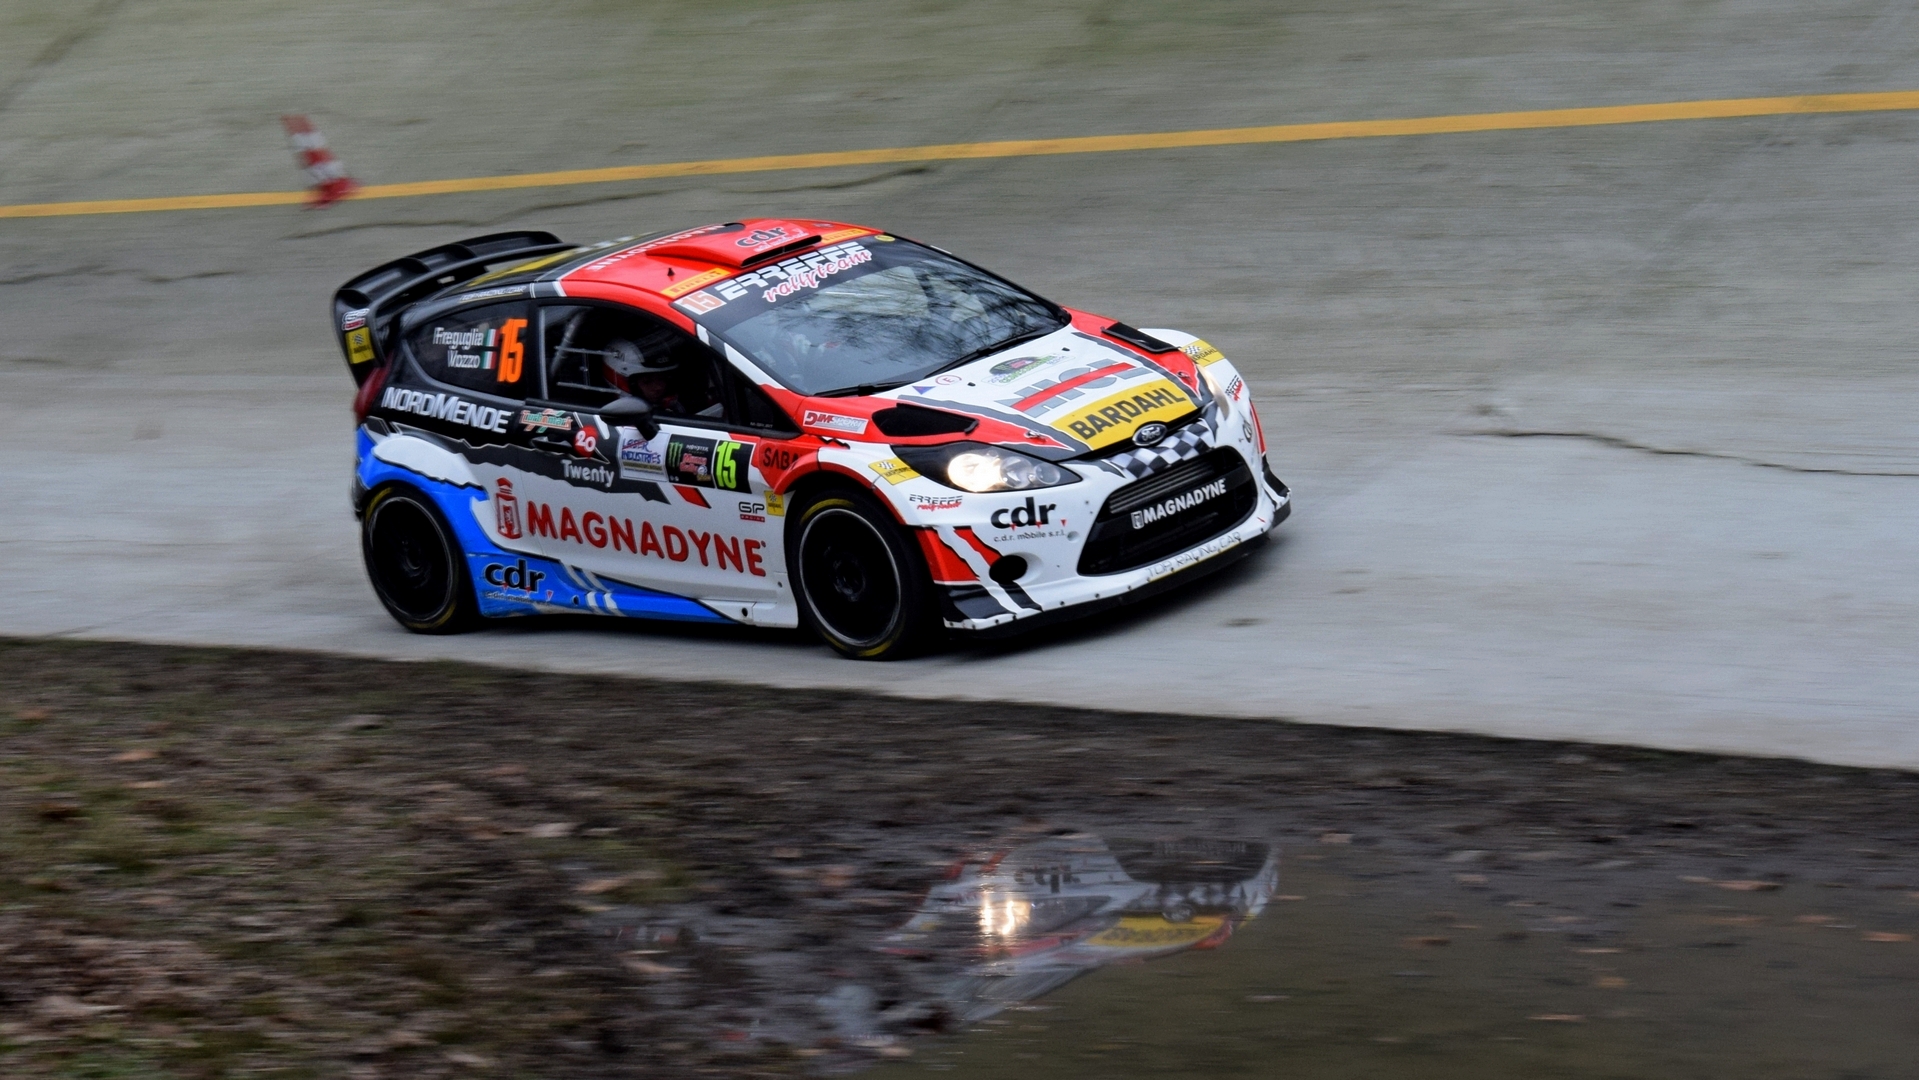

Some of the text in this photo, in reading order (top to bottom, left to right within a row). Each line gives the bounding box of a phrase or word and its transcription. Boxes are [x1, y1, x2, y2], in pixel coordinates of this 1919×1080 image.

[715, 242, 869, 300] ERREFFE
[763, 250, 872, 302] rallyteam
[680, 291, 719, 312] 15
[497, 318, 528, 383] 15
[381, 387, 514, 433] NORDMENDE
[1068, 388, 1187, 440] BARDAHL
[575, 430, 596, 452] 20
[561, 459, 615, 488] Twenty
[716, 441, 741, 489] 15
[739, 501, 765, 514] GP
[991, 497, 1056, 529] cdr
[1143, 479, 1226, 524] MAGNADYNE
[527, 501, 766, 577] MAGNADYNE
[484, 558, 546, 593] cdr
